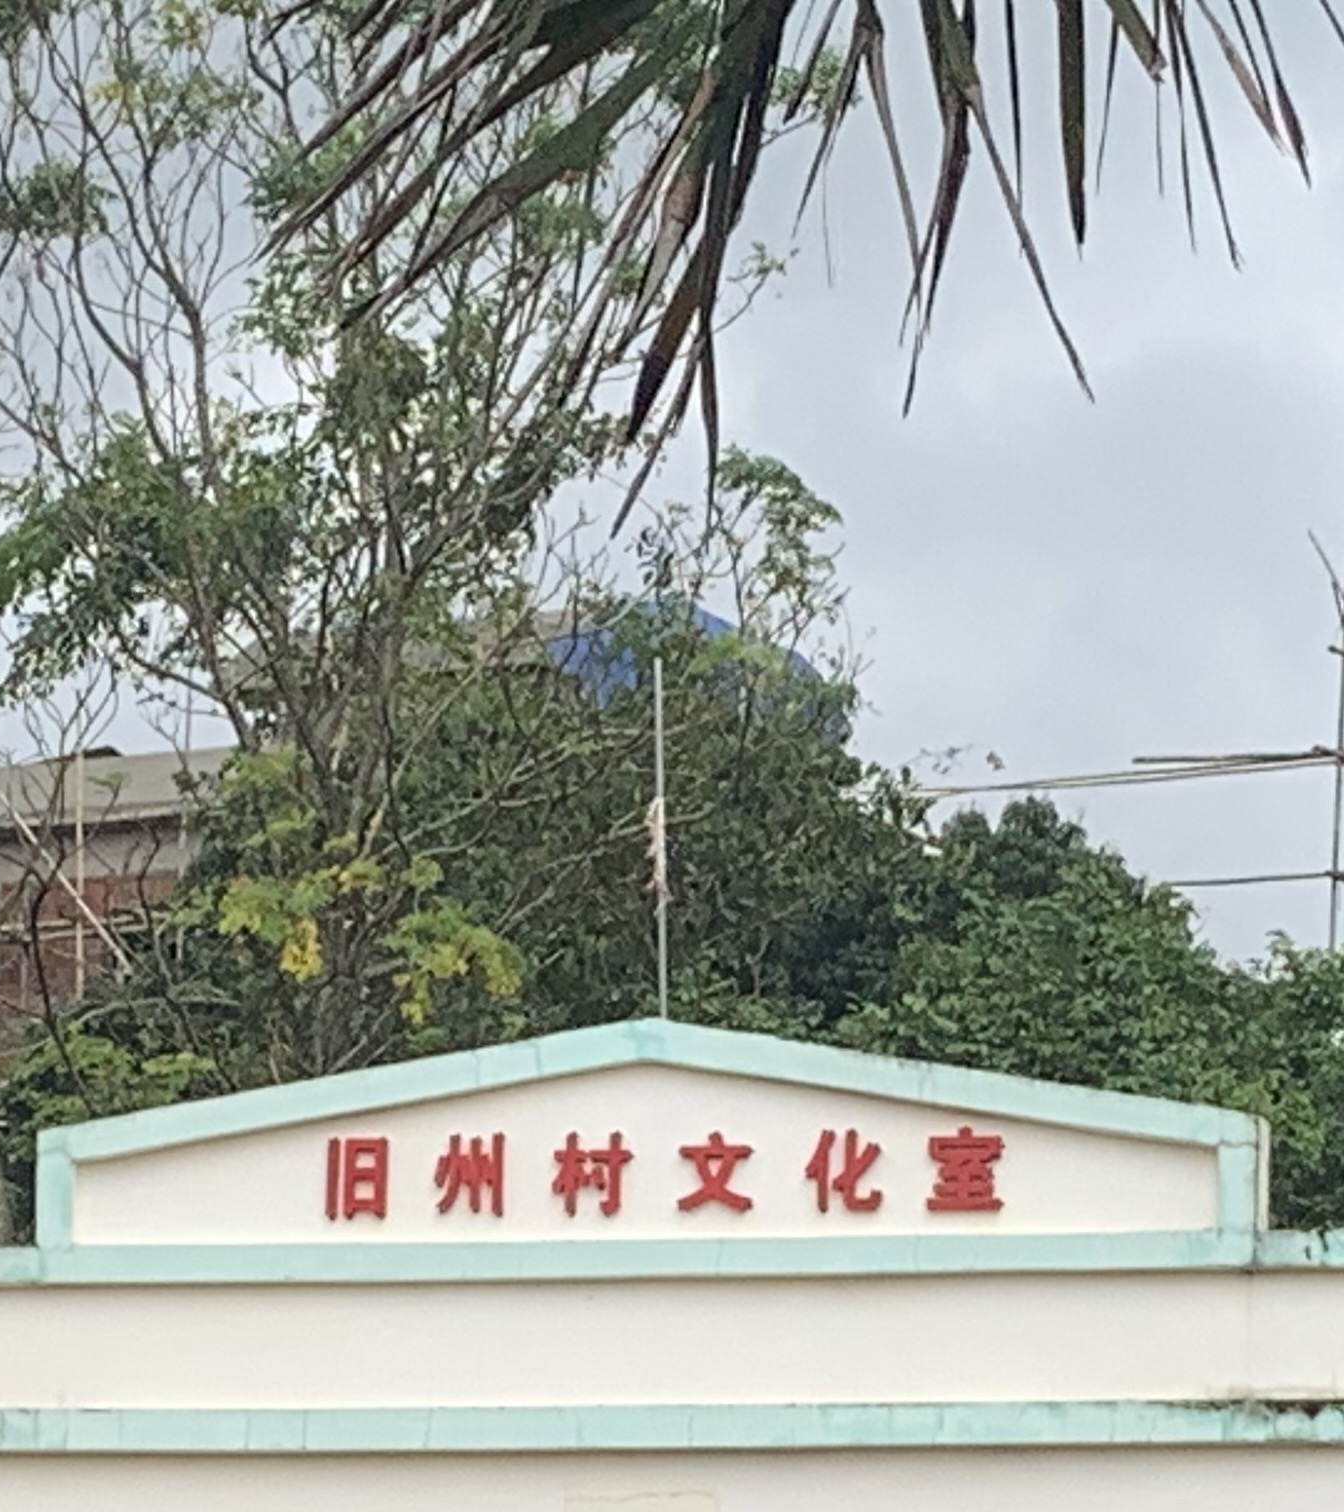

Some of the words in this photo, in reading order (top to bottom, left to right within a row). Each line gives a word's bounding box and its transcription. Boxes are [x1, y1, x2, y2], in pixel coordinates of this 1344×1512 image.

[327, 1126, 1004, 1220] 旧州村文化室
